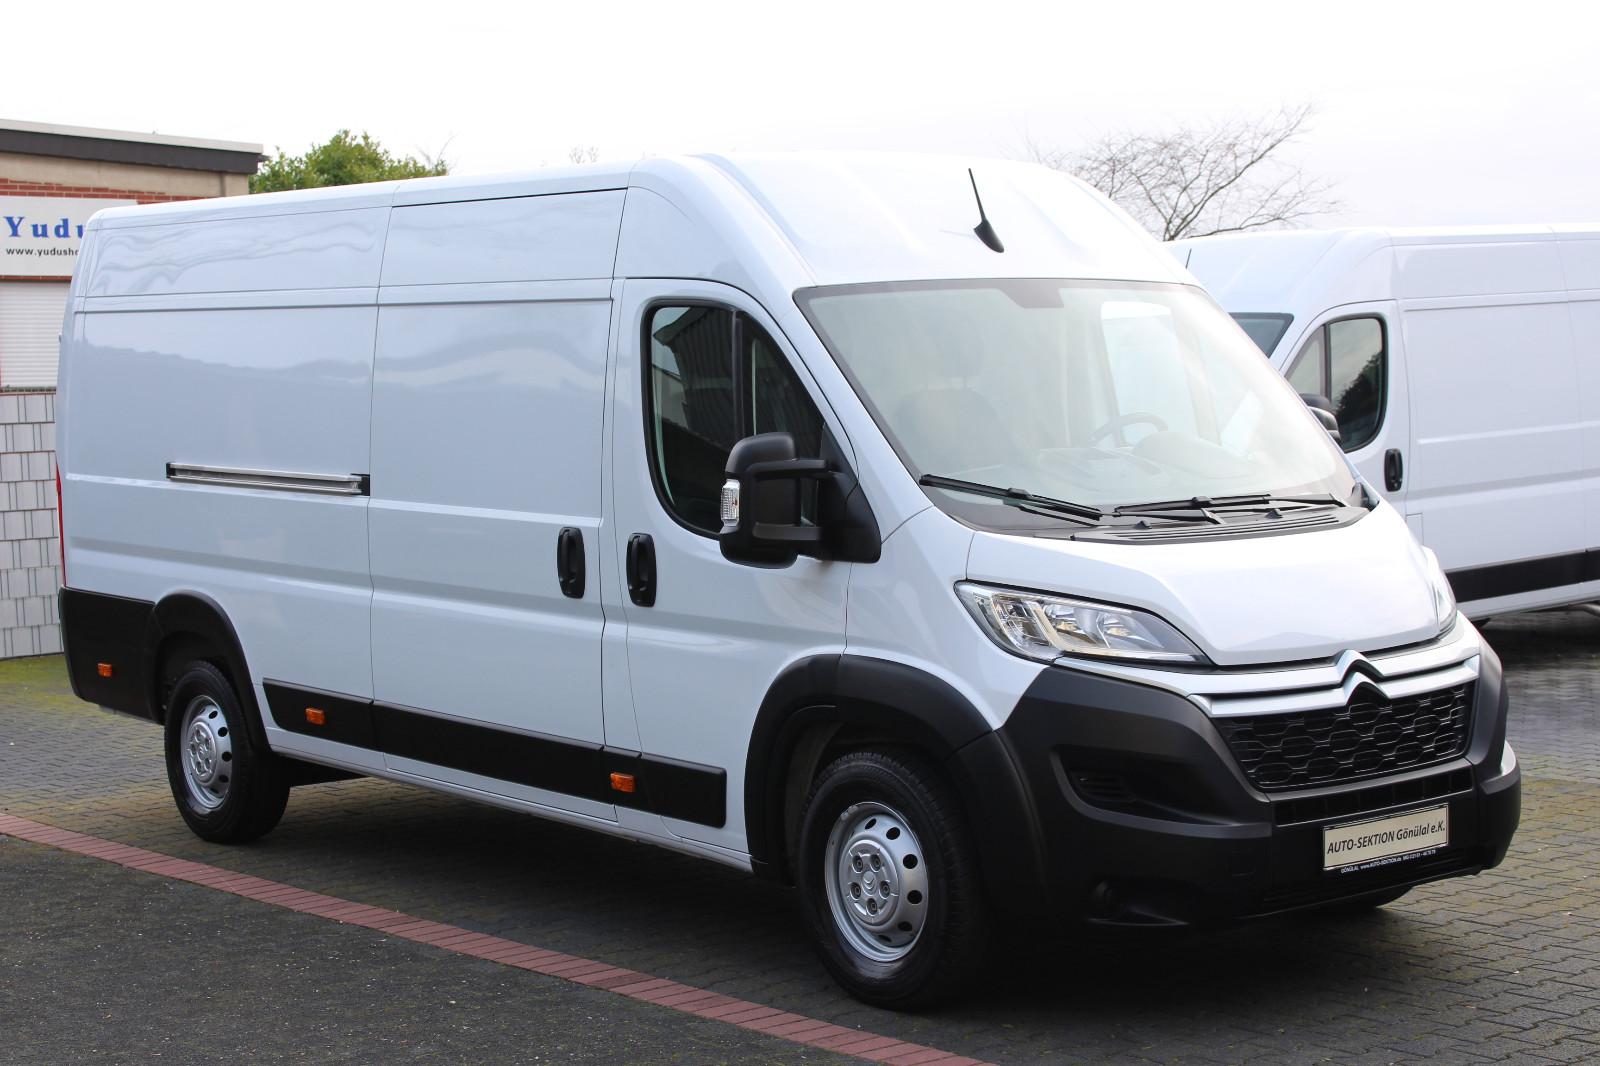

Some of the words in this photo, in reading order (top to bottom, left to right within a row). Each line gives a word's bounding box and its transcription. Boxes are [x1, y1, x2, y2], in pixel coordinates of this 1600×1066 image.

[1327, 830, 1395, 854] AUTO-SEKTION
[1396, 823, 1430, 840] Gönülal
[1430, 820, 1446, 834] e.K.
